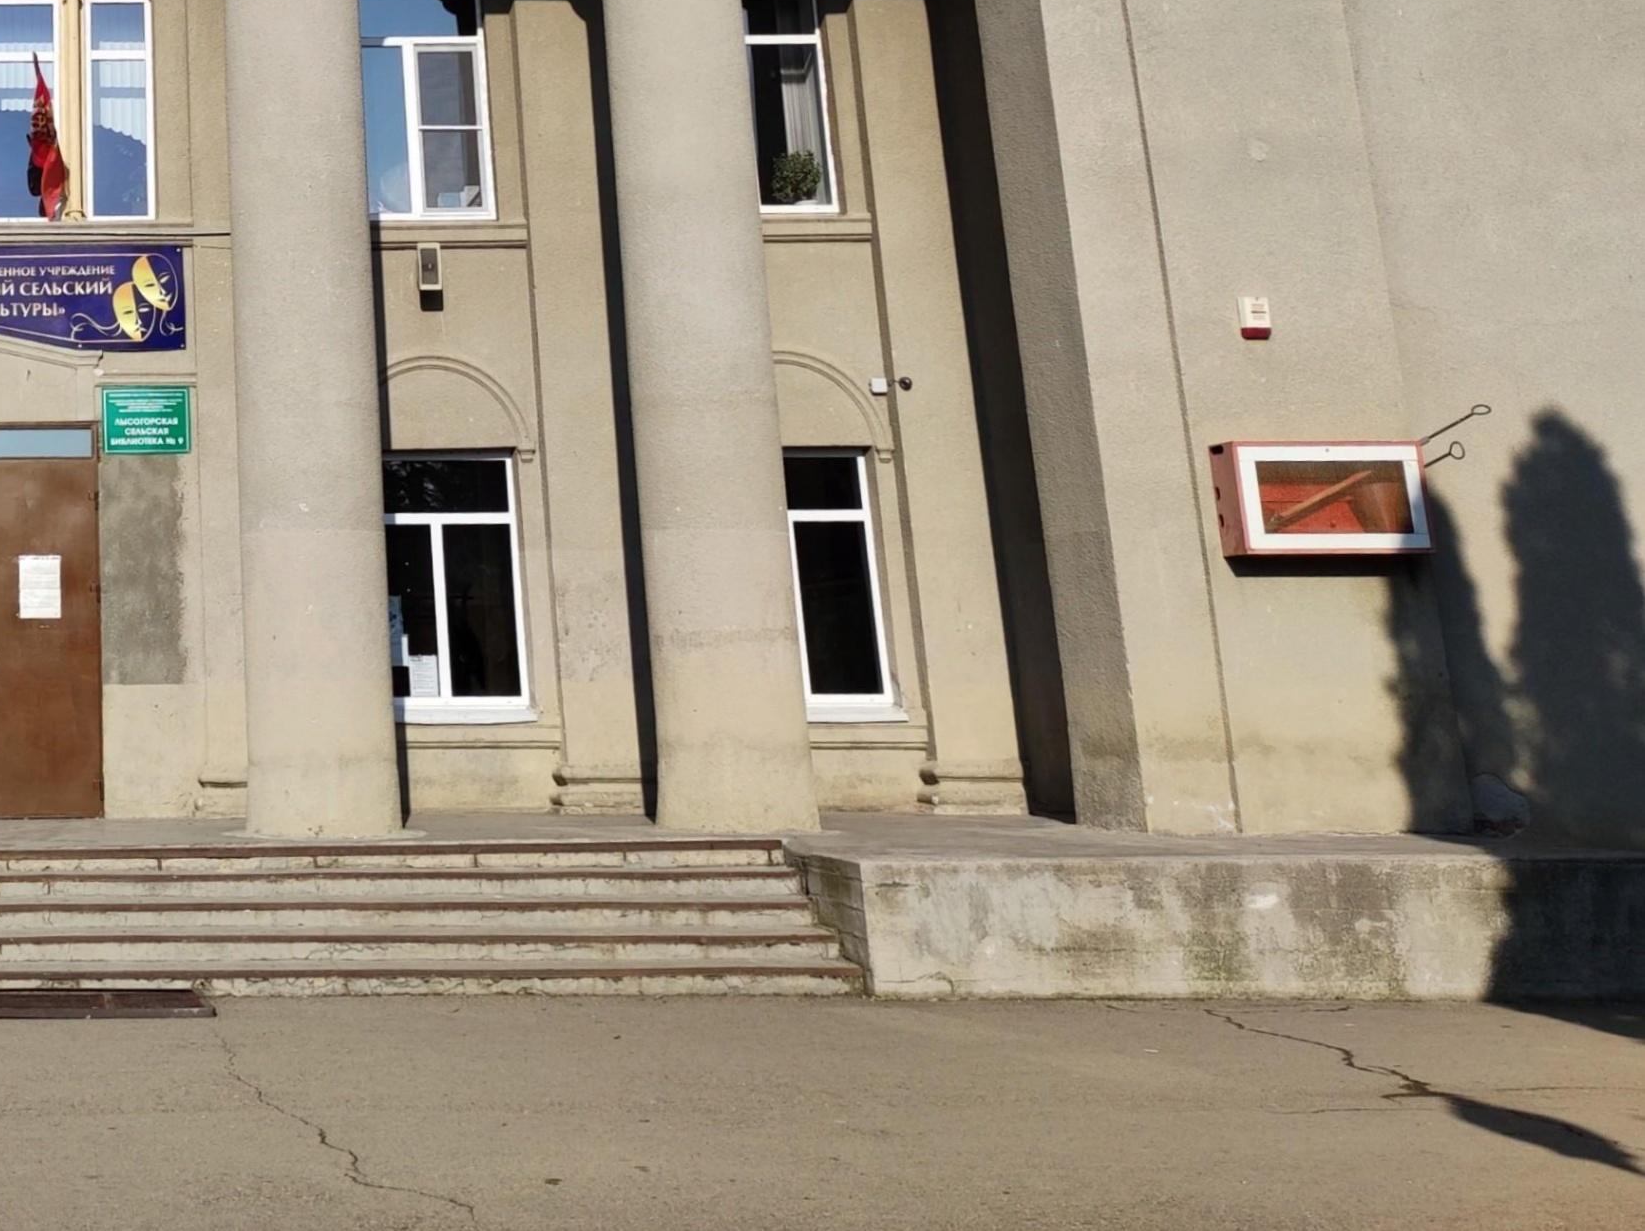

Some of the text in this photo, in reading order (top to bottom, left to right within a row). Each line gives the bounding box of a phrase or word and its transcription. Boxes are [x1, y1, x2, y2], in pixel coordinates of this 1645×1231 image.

[38, 265, 115, 276] УЧРЕЖДЕНИЕ
[19, 277, 113, 296] СЕЛЬСКИЙ
[114, 417, 178, 426] ЛЫСОГОРСКАЯ
[124, 427, 169, 436] СЕЛЬСКАЯ
[110, 437, 163, 446] БИБЛИОТЕКА
